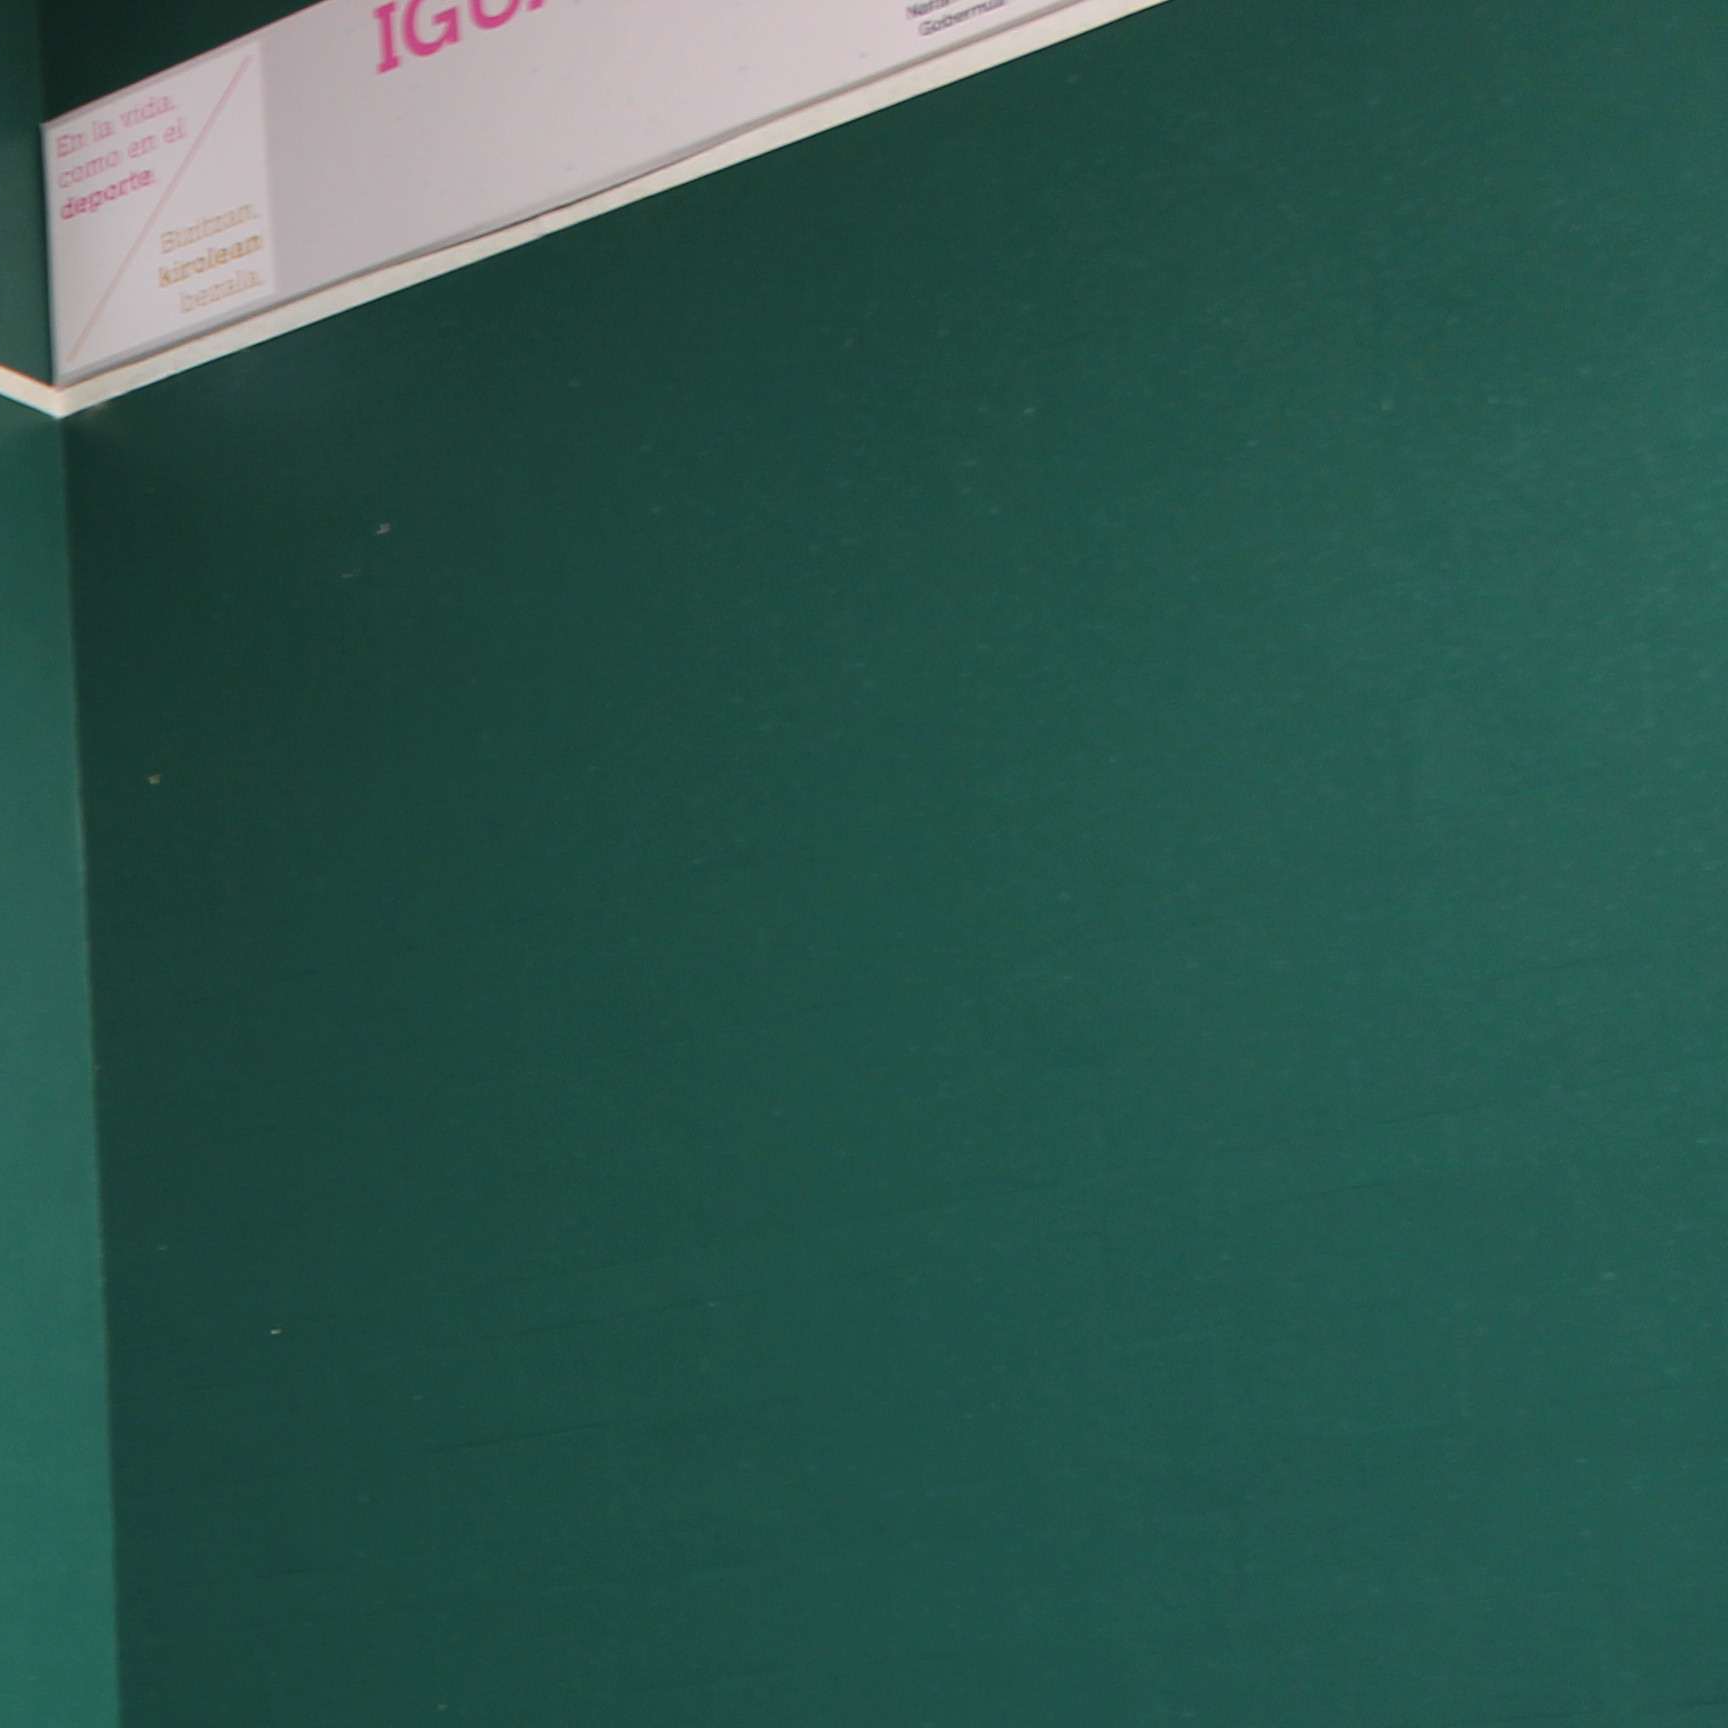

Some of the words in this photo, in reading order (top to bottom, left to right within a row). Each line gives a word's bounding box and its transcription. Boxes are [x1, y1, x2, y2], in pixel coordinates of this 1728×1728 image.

[56, 132, 87, 158] En
[91, 119, 115, 141] la
[57, 150, 121, 189] como
[127, 134, 158, 158] en
[162, 117, 188, 143] el
[157, 234, 264, 288] kirolean
